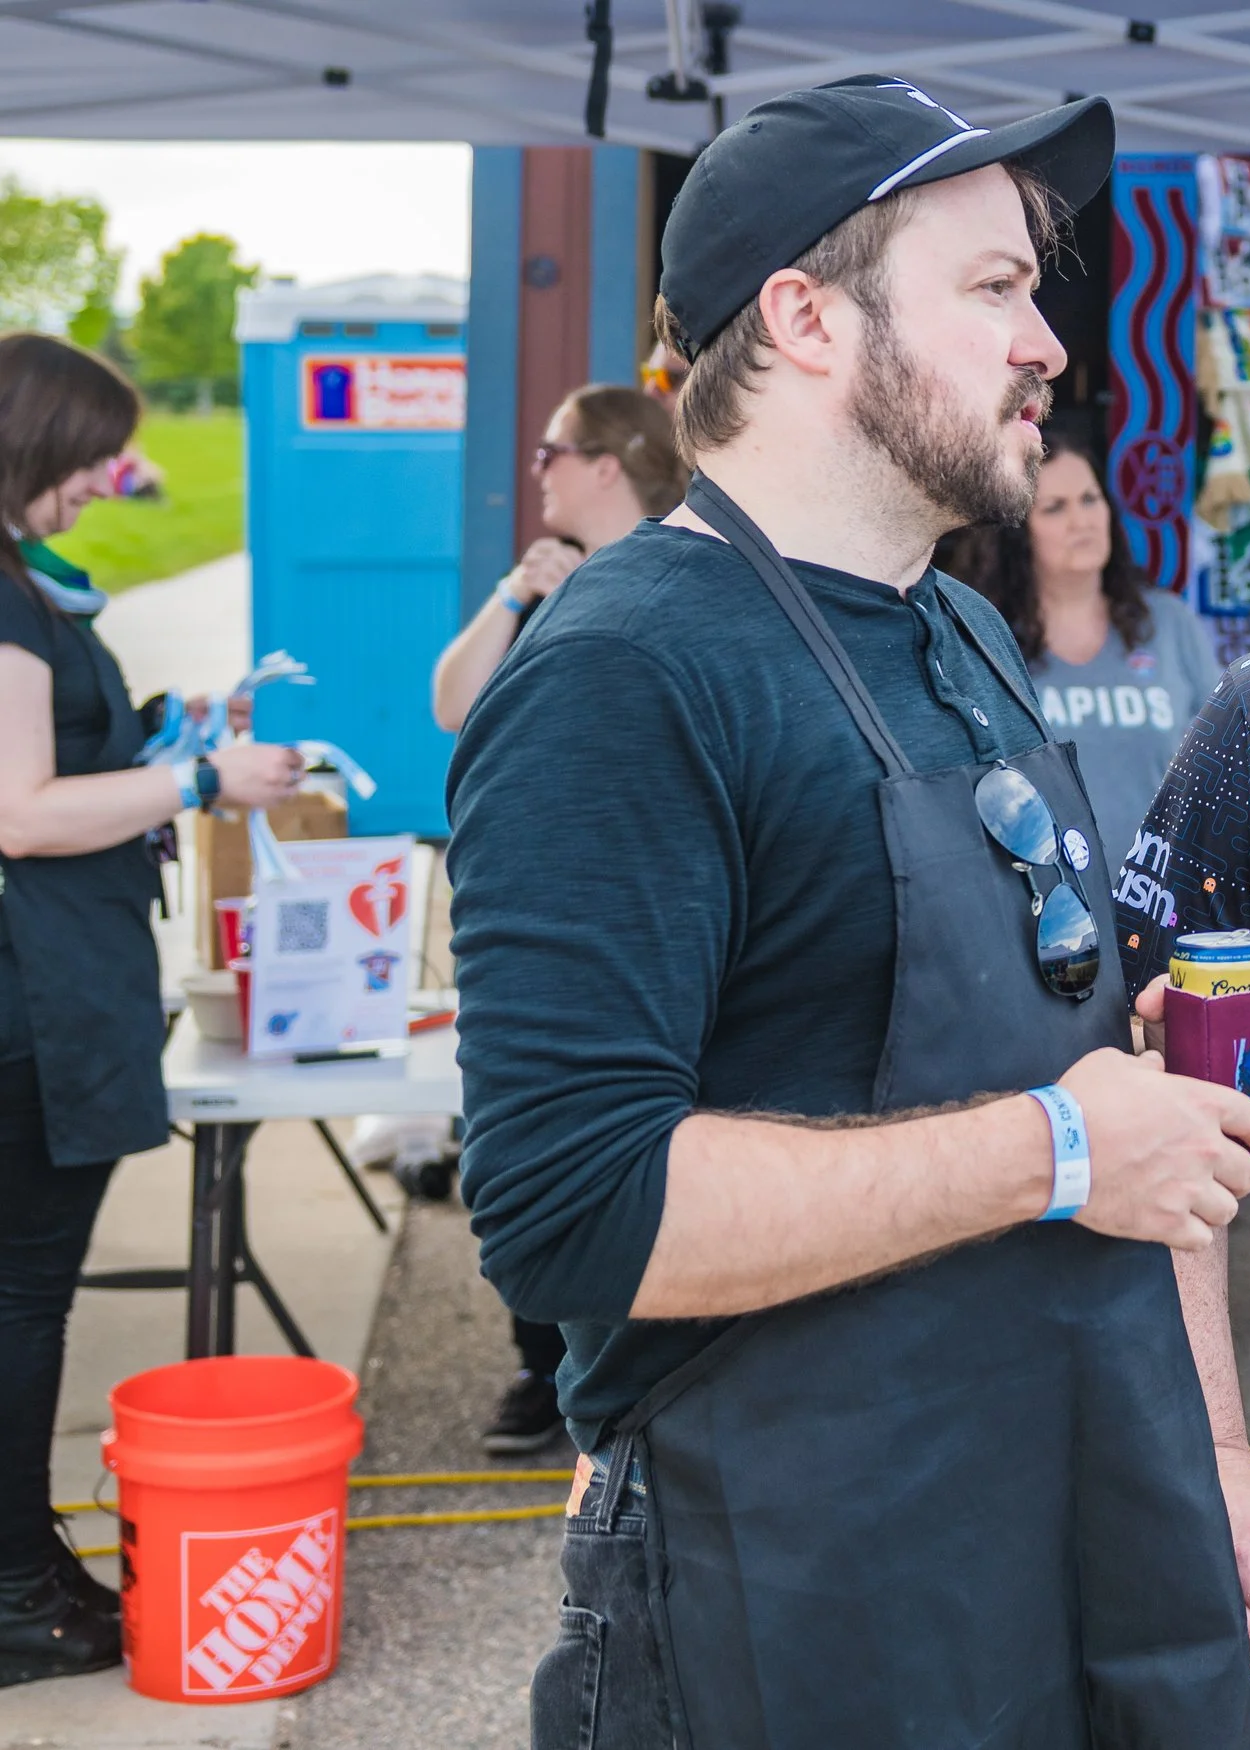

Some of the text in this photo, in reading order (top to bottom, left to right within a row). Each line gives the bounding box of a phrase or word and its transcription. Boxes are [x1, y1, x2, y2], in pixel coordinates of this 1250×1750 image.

[1042, 685, 1174, 731] APIDS
[1112, 866, 1175, 928] ism
[186, 1518, 334, 1692] HOME
[198, 1547, 274, 1617] THE
[248, 1573, 334, 1686] DEPOT
